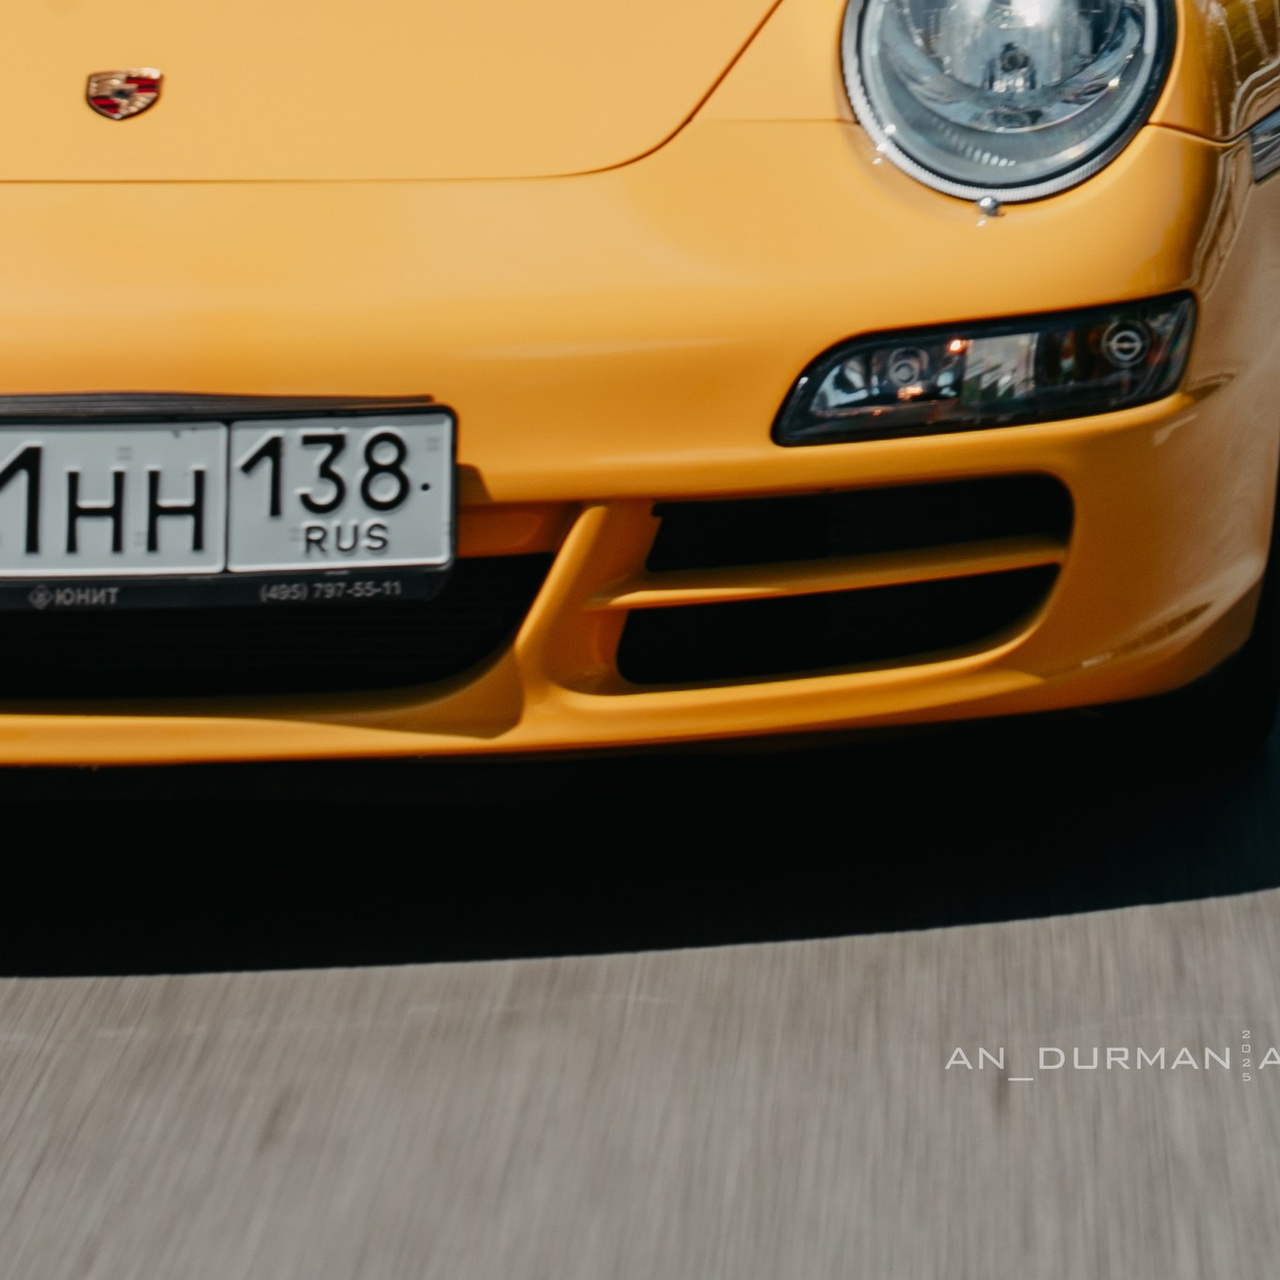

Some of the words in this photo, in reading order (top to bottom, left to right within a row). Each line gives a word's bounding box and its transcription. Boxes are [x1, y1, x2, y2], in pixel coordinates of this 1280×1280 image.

[240, 431, 412, 518] 138
[304, 523, 390, 554] RUS
[54, 587, 120, 606] ЮНИТ
[312, 580, 402, 600] 797-55-11
